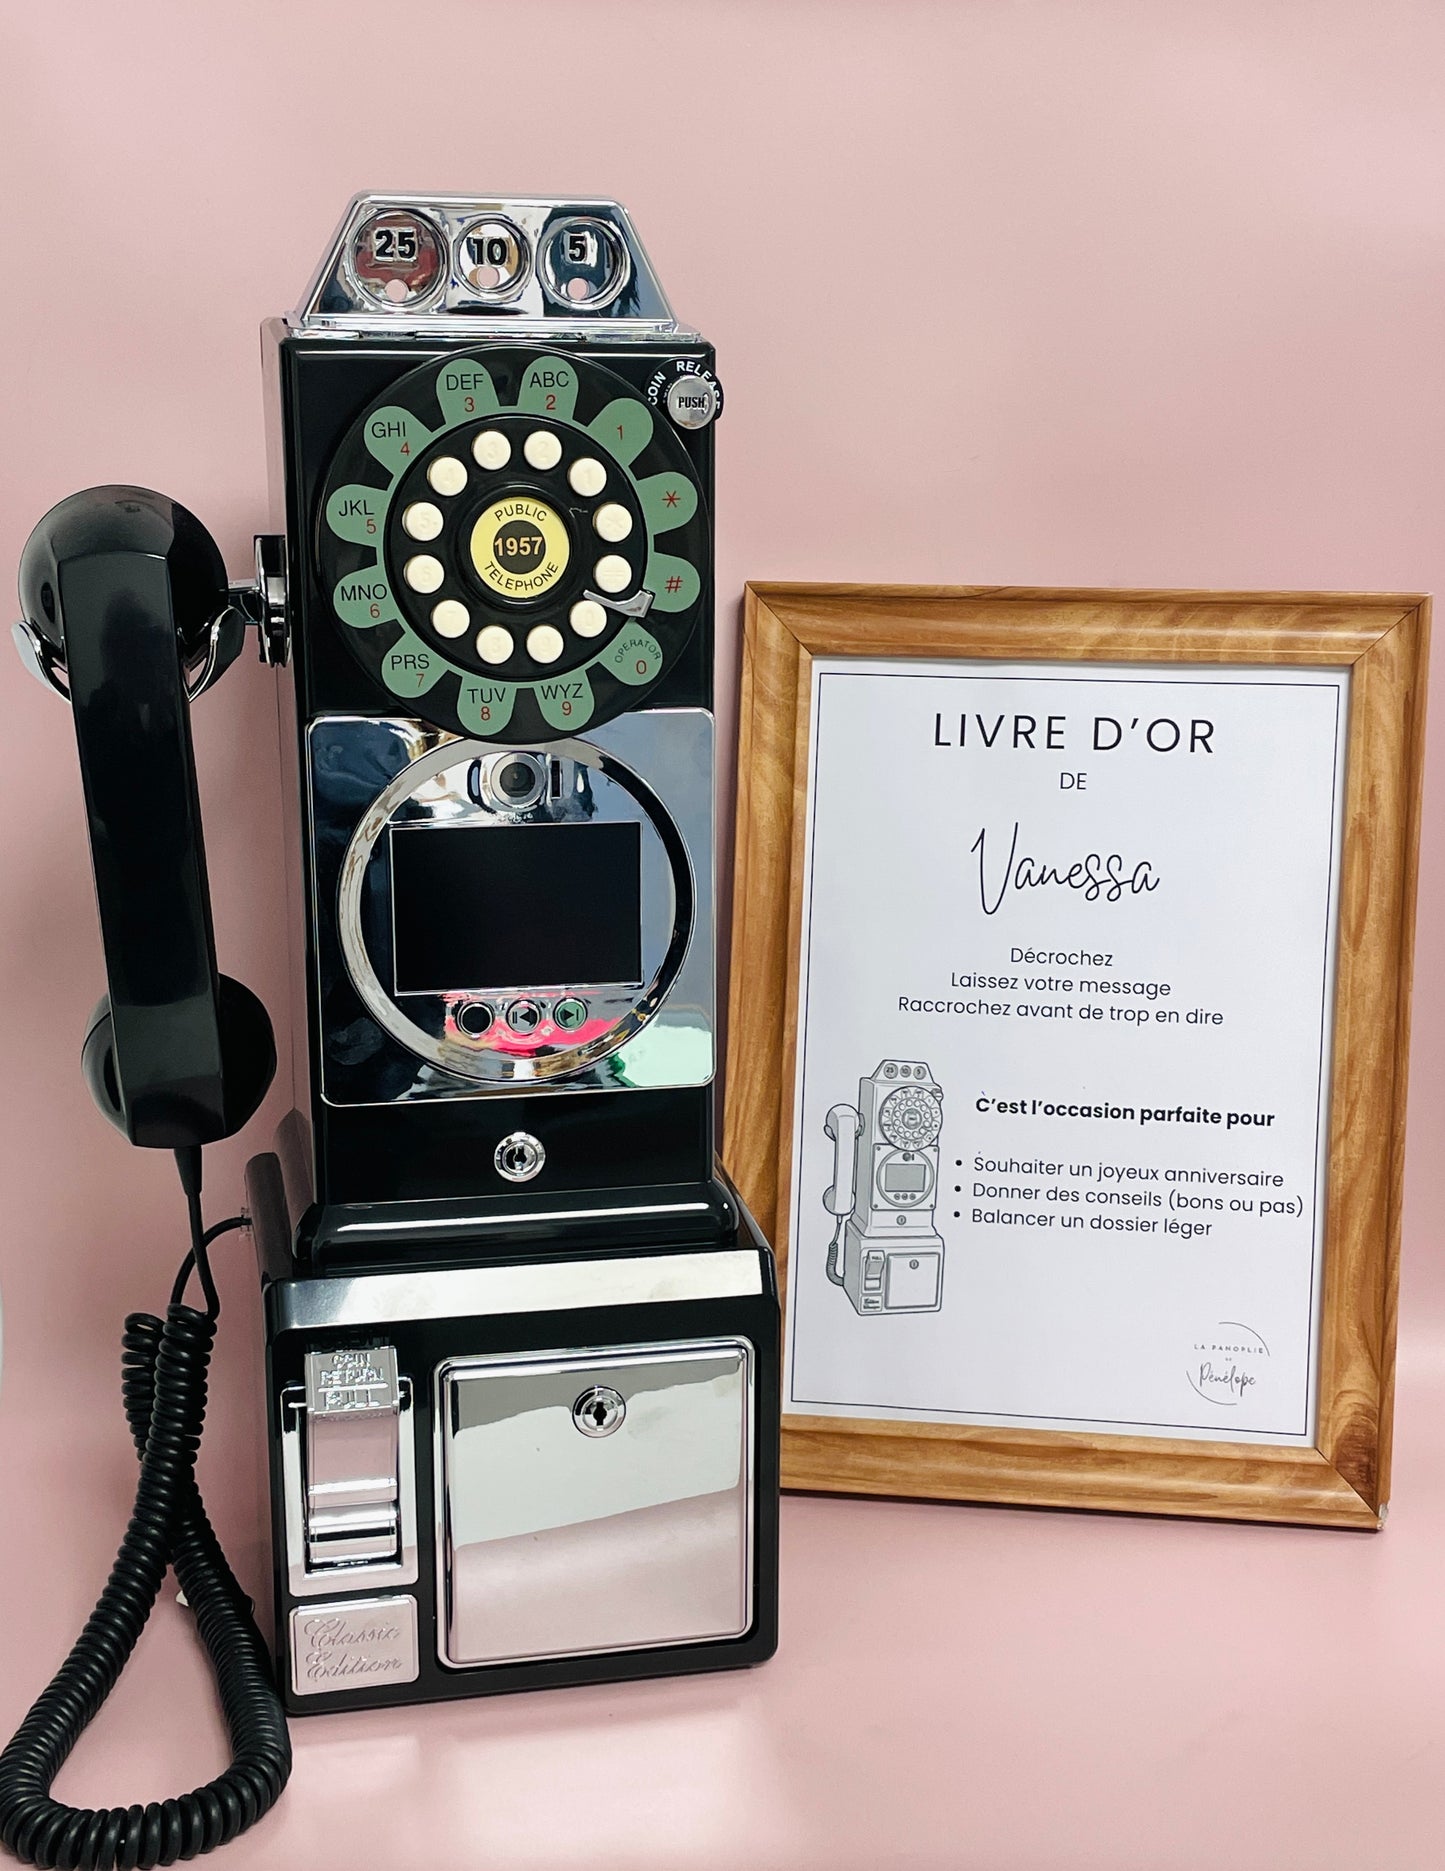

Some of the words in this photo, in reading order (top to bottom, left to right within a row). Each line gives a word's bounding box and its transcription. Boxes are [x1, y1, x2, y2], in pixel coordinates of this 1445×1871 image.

[375, 231, 417, 262] 25
[474, 237, 507, 266] 10
[568, 234, 588, 263] 5
[446, 373, 484, 391] DEF
[529, 371, 569, 388] ABC
[648, 371, 666, 406] COIN
[465, 397, 474, 412] 3
[546, 394, 556, 410] 2
[678, 397, 705, 409] PUSH
[372, 421, 406, 438] GHI
[617, 425, 622, 440] 1
[400, 442, 410, 456] 4
[339, 500, 375, 516] JKL
[494, 504, 547, 522] PUBLIC
[367, 519, 376, 534] 5
[494, 536, 543, 556] 1957
[485, 562, 559, 591] TELEPHONE
[341, 584, 387, 601] MNO
[370, 603, 380, 618] 6
[615, 638, 662, 664] OPERATOR
[389, 654, 429, 670] PRS
[636, 660, 647, 674] 0
[416, 673, 424, 688] 7
[467, 687, 506, 704] TUV
[540, 682, 583, 700] WYZ
[481, 706, 490, 721] 8
[562, 701, 572, 716] 9
[935, 713, 1066, 749] LIVRE
[1060, 772, 1087, 790] DE
[971, 822, 1160, 915] Vanessa
[1011, 947, 1113, 966] Décrochez
[952, 972, 1018, 989] Laissez
[1024, 977, 1073, 991] votre
[1080, 981, 1171, 1000] message
[899, 997, 1011, 1016] Raccrochez
[1017, 1004, 1073, 1018] avant
[1079, 1004, 1103, 1020] de
[1110, 1006, 1149, 1026] trop
[1156, 1011, 1179, 1023] en
[1186, 1009, 1223, 1025] dire
[1140, 1106, 1222, 1125] parfaite
[1227, 1113, 1275, 1129] pour
[974, 1157, 1064, 1175] Souhaiter
[1070, 1165, 1092, 1177] un
[1097, 1162, 1159, 1183] joyeux
[1165, 1168, 1283, 1187] anniversaire
[973, 1183, 1040, 1200] Donner
[1046, 1186, 1079, 1202] des
[1086, 1191, 1161, 1206] conseils
[1169, 1189, 1223, 1211] (bons
[1230, 1200, 1253, 1211] ou
[1260, 1195, 1303, 1218] pas)
[972, 1208, 1055, 1227] Balancer
[1061, 1216, 1084, 1228] un
[1090, 1214, 1158, 1232] dossier
[1164, 1218, 1212, 1239] léger
[304, 1619, 400, 1650] Classic
[306, 1652, 402, 1682] Edition
